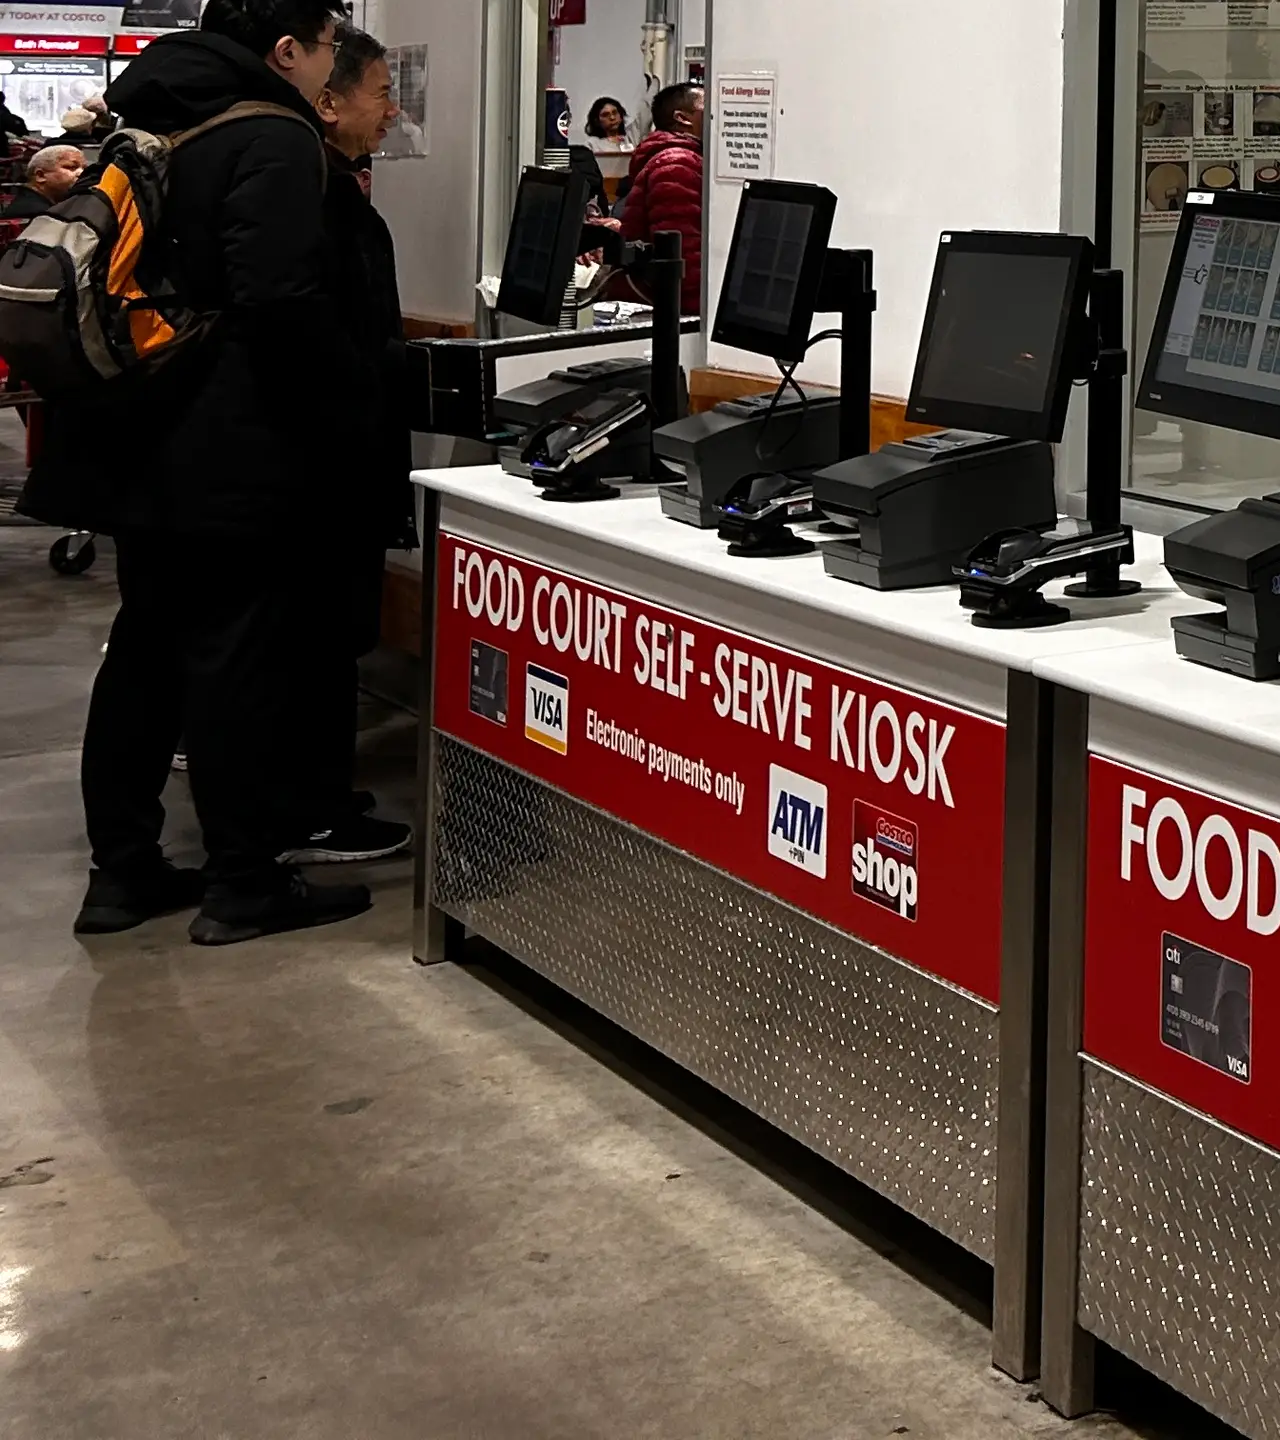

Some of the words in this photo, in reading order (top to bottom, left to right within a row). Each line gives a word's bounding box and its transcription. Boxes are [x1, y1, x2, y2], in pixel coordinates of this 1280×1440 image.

[9, 11, 43, 20] TODAY
[46, 12, 59, 20] AT
[63, 13, 105, 22] COSTCO
[453, 547, 524, 633] FOOD
[533, 575, 626, 673] COURT
[831, 683, 955, 809] KIOSK
[530, 686, 562, 731] VISA
[586, 708, 645, 762] Electronic
[648, 734, 711, 795] payments
[715, 769, 744, 815] only
[771, 789, 823, 855] ATM
[876, 816, 914, 847] COSTCO
[852, 837, 917, 918] shop
[1227, 1055, 1247, 1078] VISA
